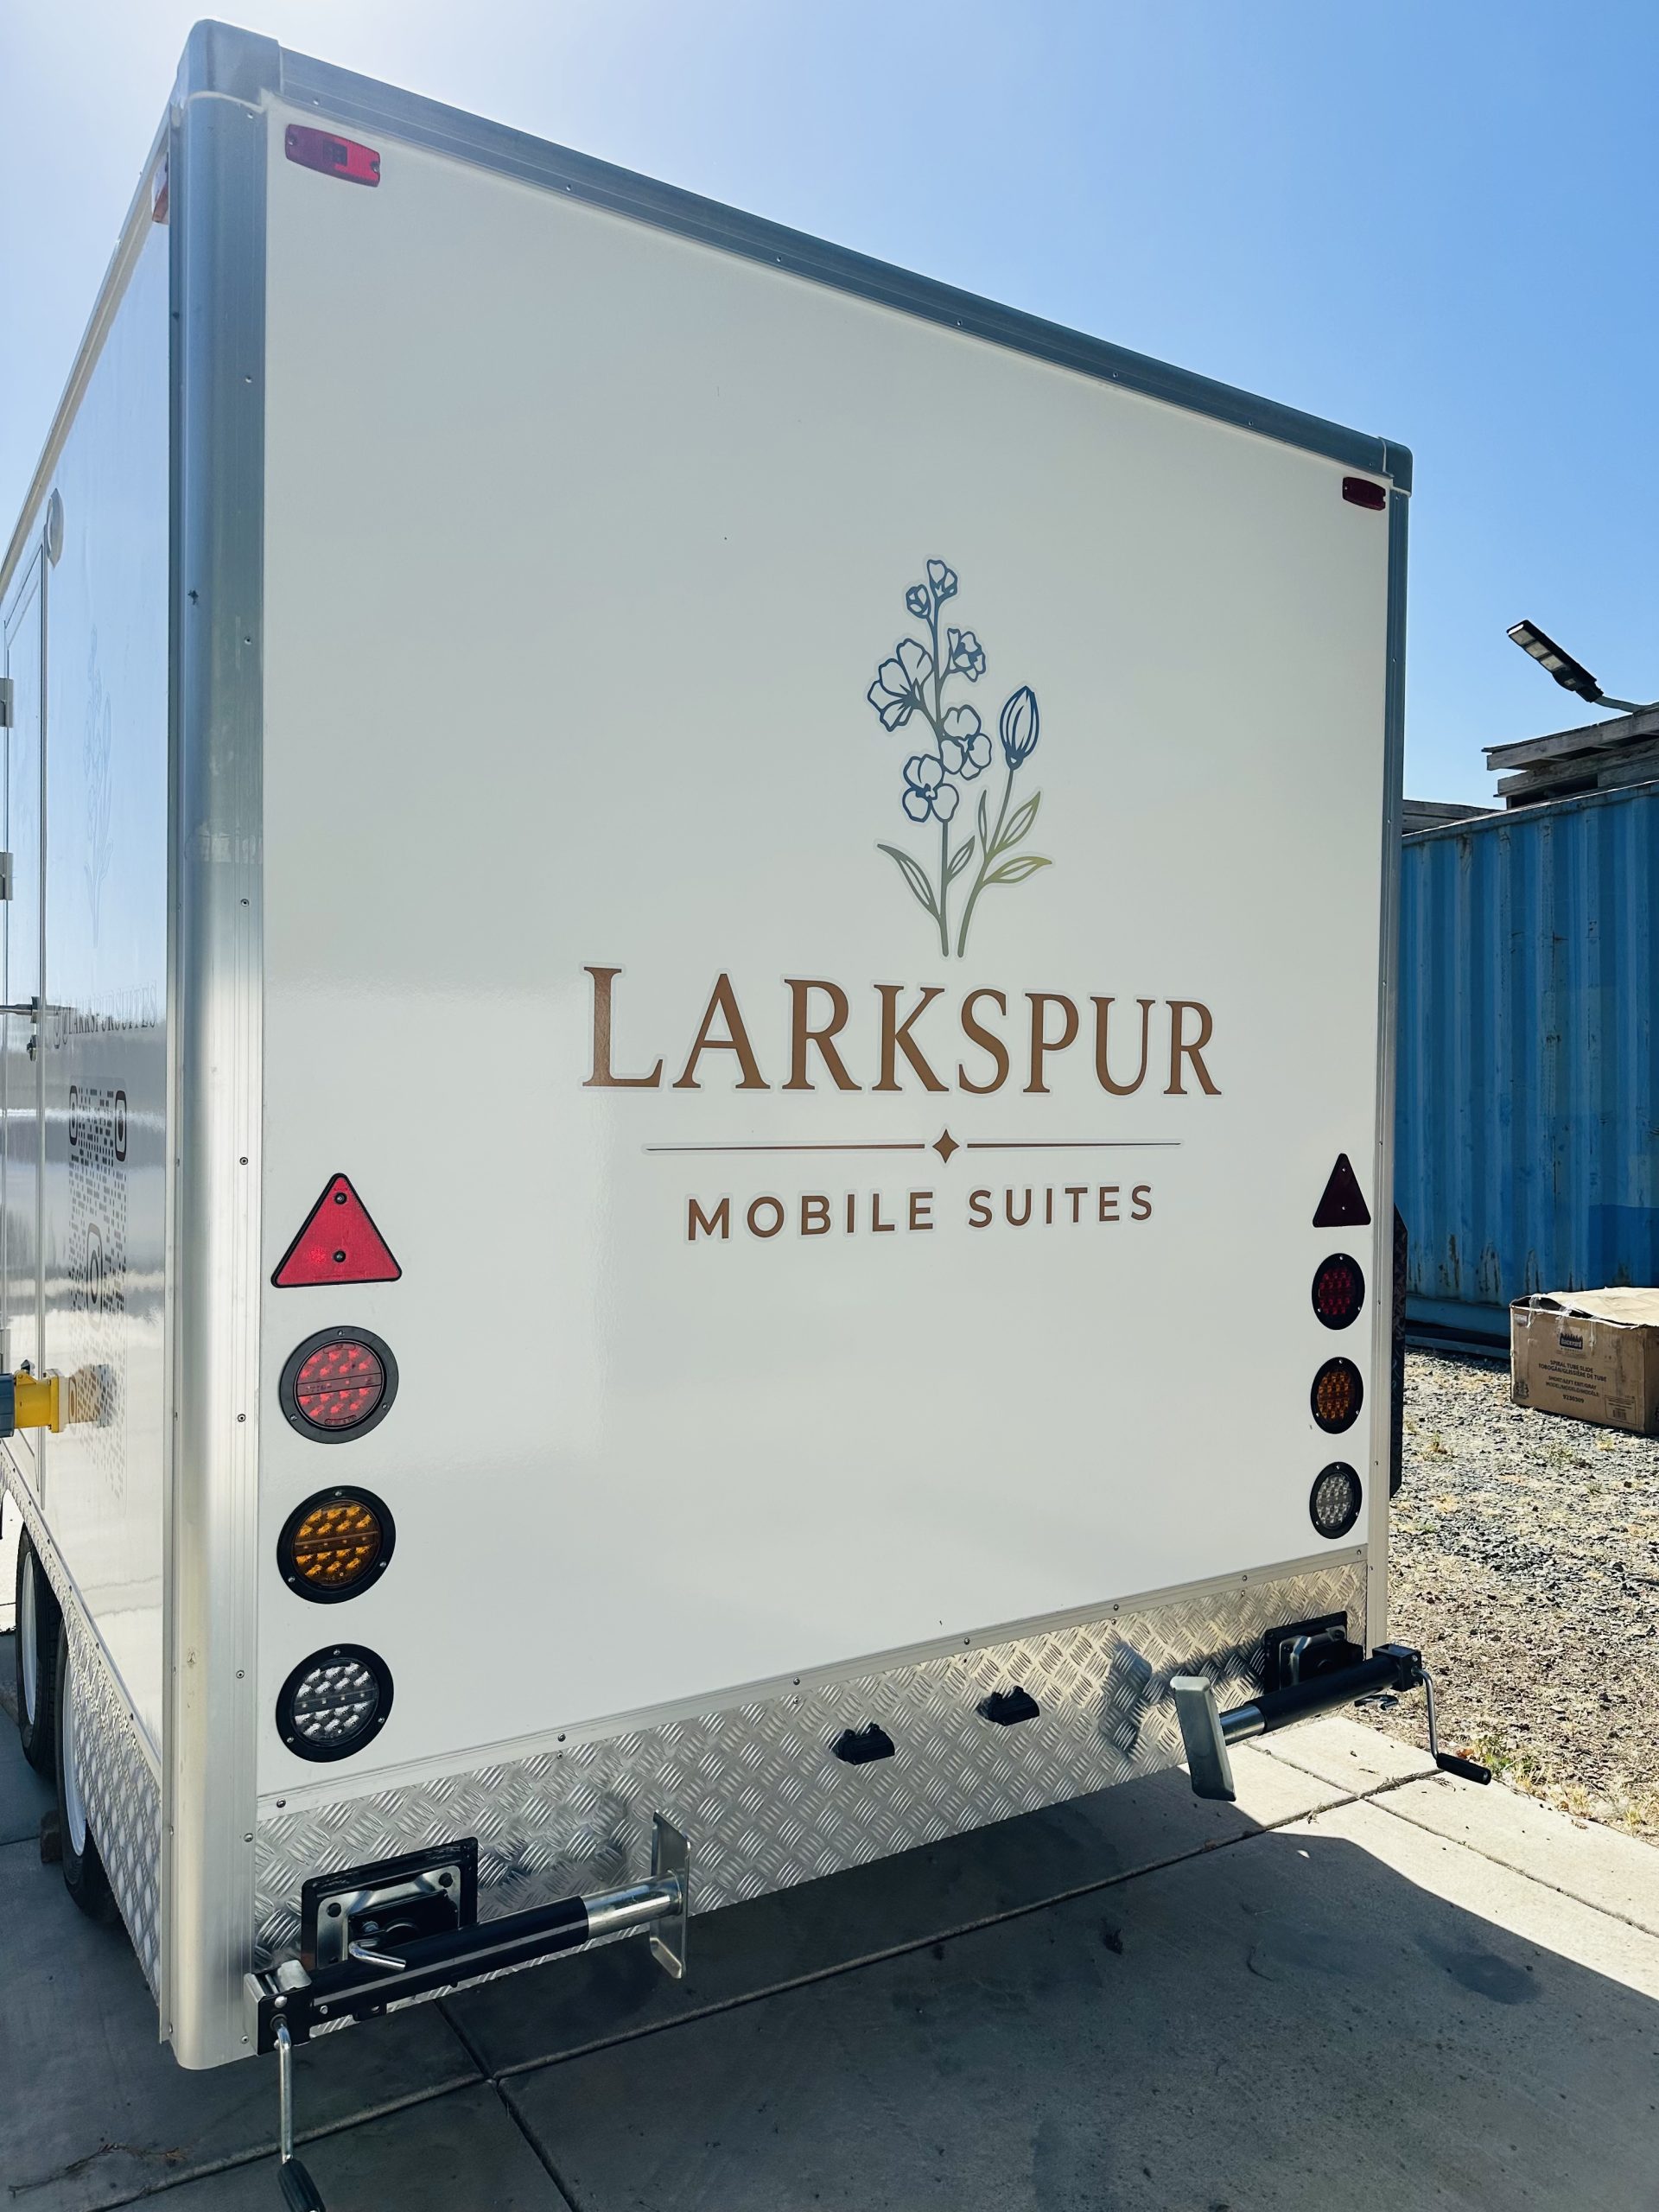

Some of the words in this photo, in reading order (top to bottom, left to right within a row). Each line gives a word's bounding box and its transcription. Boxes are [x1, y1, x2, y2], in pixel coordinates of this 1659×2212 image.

[582, 966, 1223, 1096] LARKSPUR
[687, 1191, 935, 1241] MOBILE
[968, 1185, 1154, 1228] SUITES
[1550, 1359, 1566, 1368] SPIRAL
